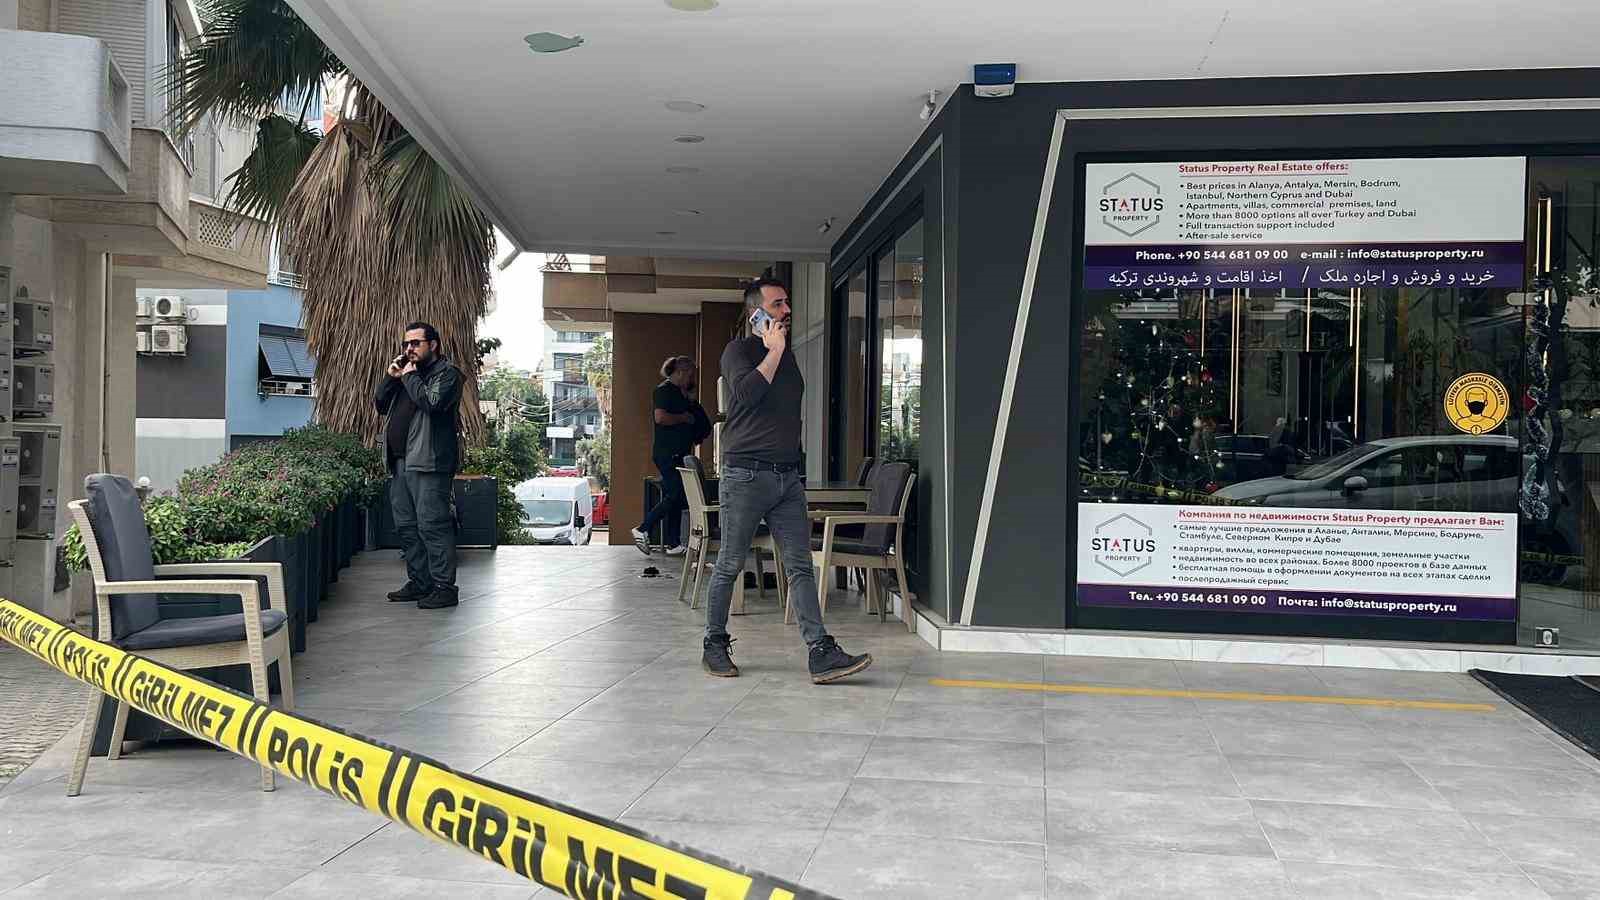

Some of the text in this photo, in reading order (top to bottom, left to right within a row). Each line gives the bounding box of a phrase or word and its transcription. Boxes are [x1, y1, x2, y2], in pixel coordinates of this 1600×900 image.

[1179, 162, 1349, 174] Status Property Real Estate offers:
[1208, 182, 1235, 191] prices
[1249, 182, 1282, 191] Alanya,
[1284, 180, 1321, 190] Antalya,
[1324, 180, 1358, 188] Mersin,
[1360, 180, 1400, 188] Bodrum,
[1186, 192, 1224, 200] Istanbul,
[1271, 191, 1302, 200] Cyprus
[1324, 190, 1352, 198] Dubai
[1100, 198, 1164, 211] STATUS
[1186, 202, 1240, 210] Apartments,
[1329, 201, 1374, 209] premises,
[1261, 212, 1295, 220] options
[1335, 210, 1365, 219] Turkey
[1257, 222, 1292, 230] support
[1136, 250, 1288, 260] Phone. +90 544 681 09 00
[1300, 249, 1337, 259] e-mail
[1348, 248, 1484, 260] info@statusproperty.ru
[1109, 270, 1138, 286] ترکیه
[1143, 271, 1199, 286] شهروندی
[1204, 274, 1212, 285] و
[1216, 270, 1254, 283] اقامت
[1259, 270, 1282, 283] اخذ
[1320, 269, 1348, 282] ملک
[1354, 270, 1385, 284] اجاره
[1392, 273, 1399, 284] و
[1405, 269, 1441, 284] فروش
[1448, 273, 1455, 284] و
[1461, 270, 1495, 284] خرید
[1179, 510, 1231, 519] Компания
[1249, 512, 1329, 522] недвижимости
[1332, 513, 1364, 522] Status
[1366, 514, 1410, 525] Property
[1414, 516, 1475, 526] предлагает
[1479, 518, 1505, 526] Вам:
[1179, 533, 1224, 541] Стамбуле,
[1225, 533, 1270, 542] Северном
[1274, 534, 1303, 543] Кипре
[1313, 536, 1341, 544] Дубае
[1209, 526, 1241, 534] лучшие
[1351, 528, 1392, 536] Анталии,
[1394, 529, 1438, 538] Мерсине,
[1440, 530, 1484, 539] Бодруме,
[1092, 538, 1156, 552] STATUS
[1257, 548, 1323, 556] коммерческие
[1280, 557, 1320, 566] районах.
[1274, 567, 1332, 575] оформлении
[1179, 575, 1255, 583] послепродажный
[1129, 591, 1266, 604] Тел. +90 544 681 09 00
[1278, 597, 1457, 612] Почта: info@statusproperty.ru
